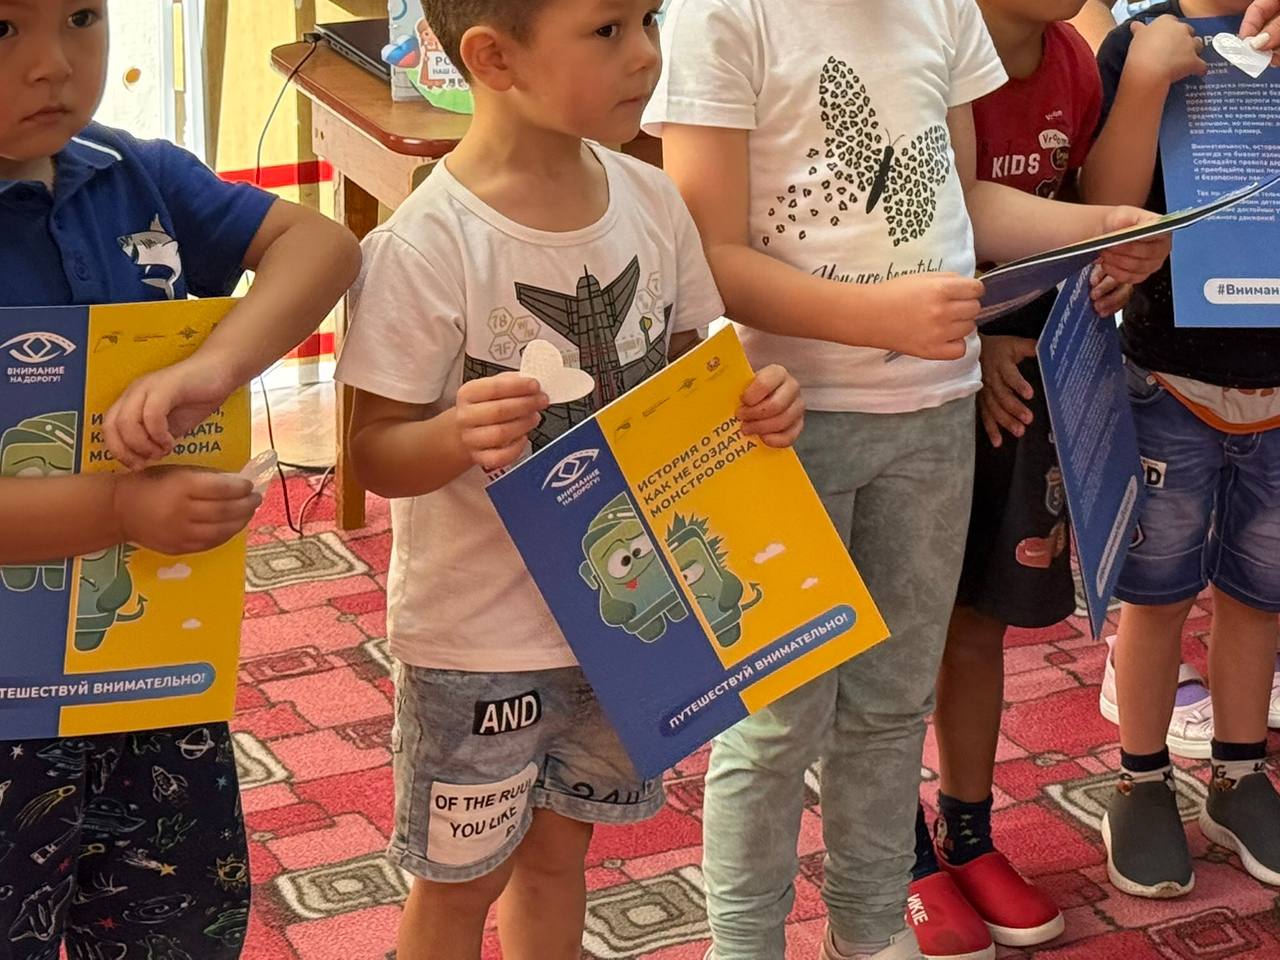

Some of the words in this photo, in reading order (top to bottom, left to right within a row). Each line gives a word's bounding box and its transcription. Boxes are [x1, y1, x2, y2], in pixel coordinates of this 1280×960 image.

[992, 153, 1040, 178] KIDS
[7, 366, 65, 376] ВНИМАНИЕ
[9, 375, 23, 383] НА
[23, 375, 61, 384] ДОРОГУ!
[637, 445, 701, 493] ИСТОРИЯ
[701, 436, 711, 447] О
[642, 480, 673, 506] КАК
[675, 467, 692, 485] НЕ
[692, 431, 741, 471] СОЗДАТ
[650, 441, 758, 518] МОНСТРОФОНА
[1146, 465, 1162, 485] D
[556, 468, 600, 503] ВНИМАНИЕ
[93, 673, 206, 695] ВНИМАТЕЛЬНО!
[668, 664, 754, 730] ПУТЕШЕСТВУЙ
[755, 612, 849, 671] ВНИМАТЕЛЬНО!
[479, 695, 537, 735] AND
[435, 794, 458, 812] OF
[465, 793, 497, 811] THE
[449, 818, 486, 839] YOU
[489, 806, 517, 831] LIKE
